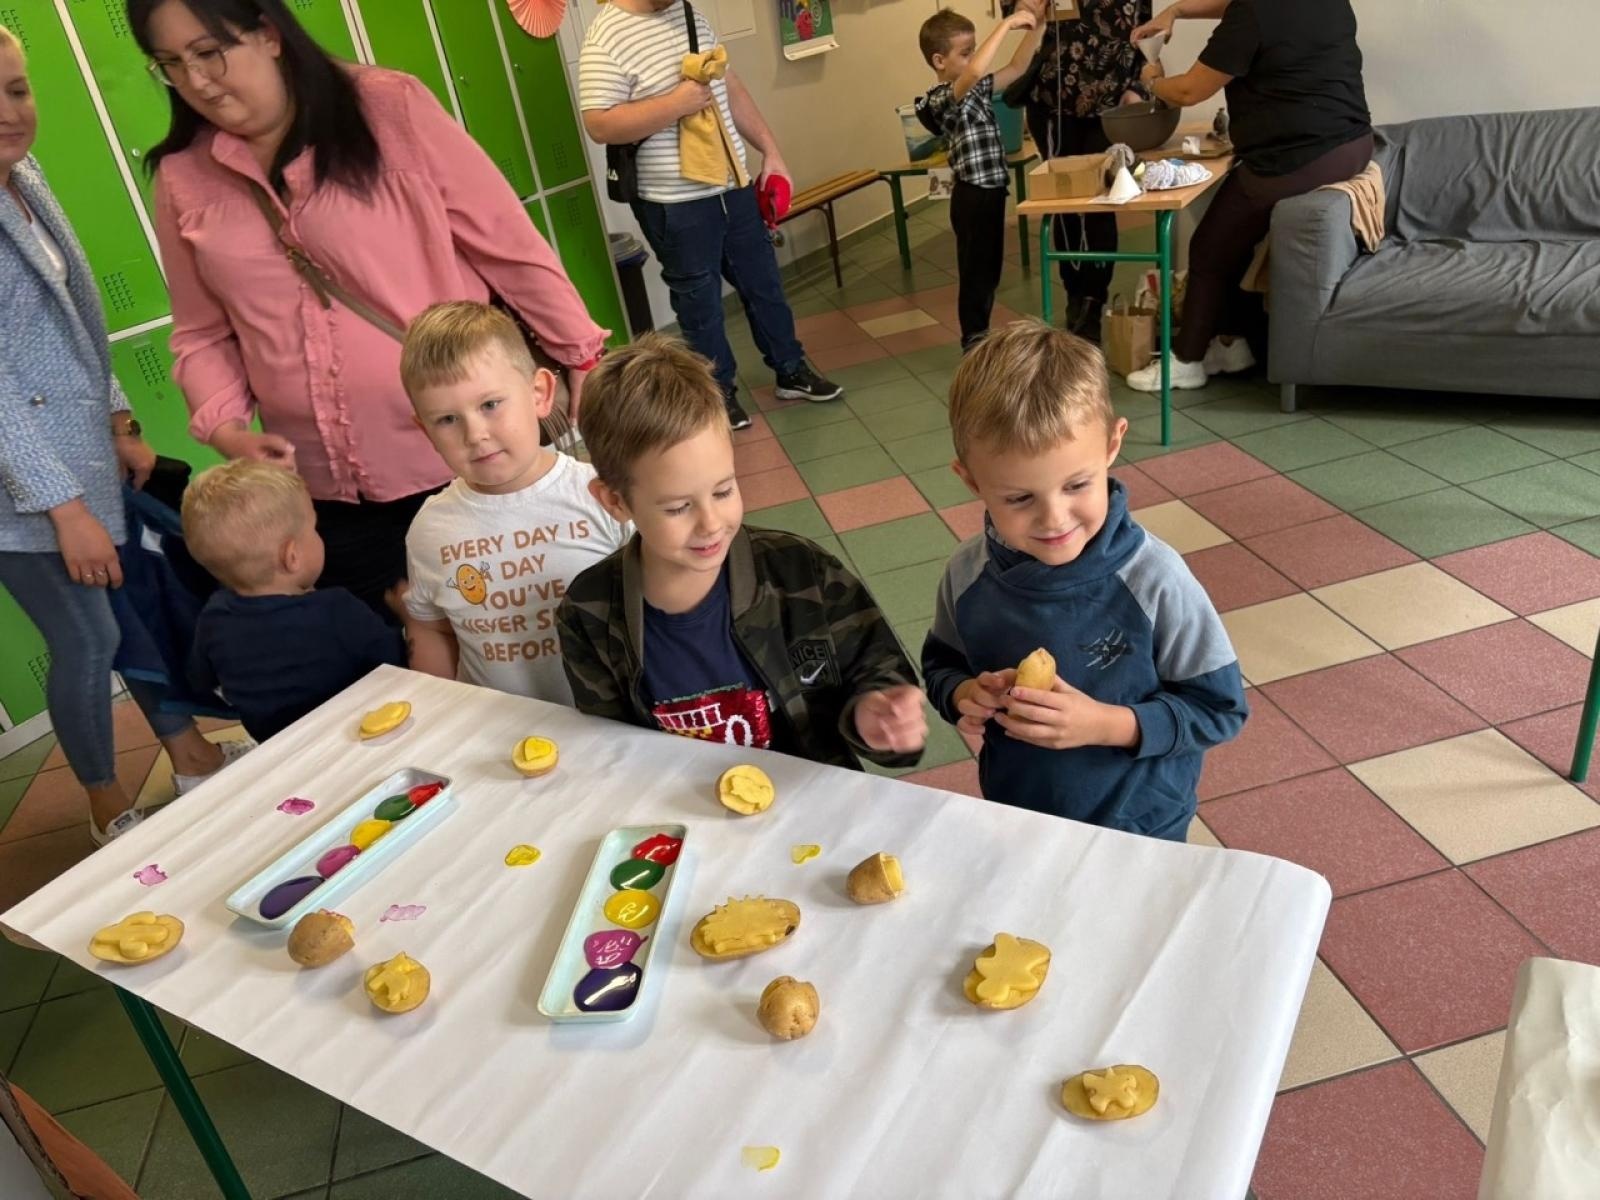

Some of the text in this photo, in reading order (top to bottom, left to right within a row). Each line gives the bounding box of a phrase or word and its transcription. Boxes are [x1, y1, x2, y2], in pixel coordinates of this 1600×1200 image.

[440, 520, 590, 565] EVERY DAY IS
[500, 554, 546, 580] DAY
[482, 638, 557, 662] BEFOR
